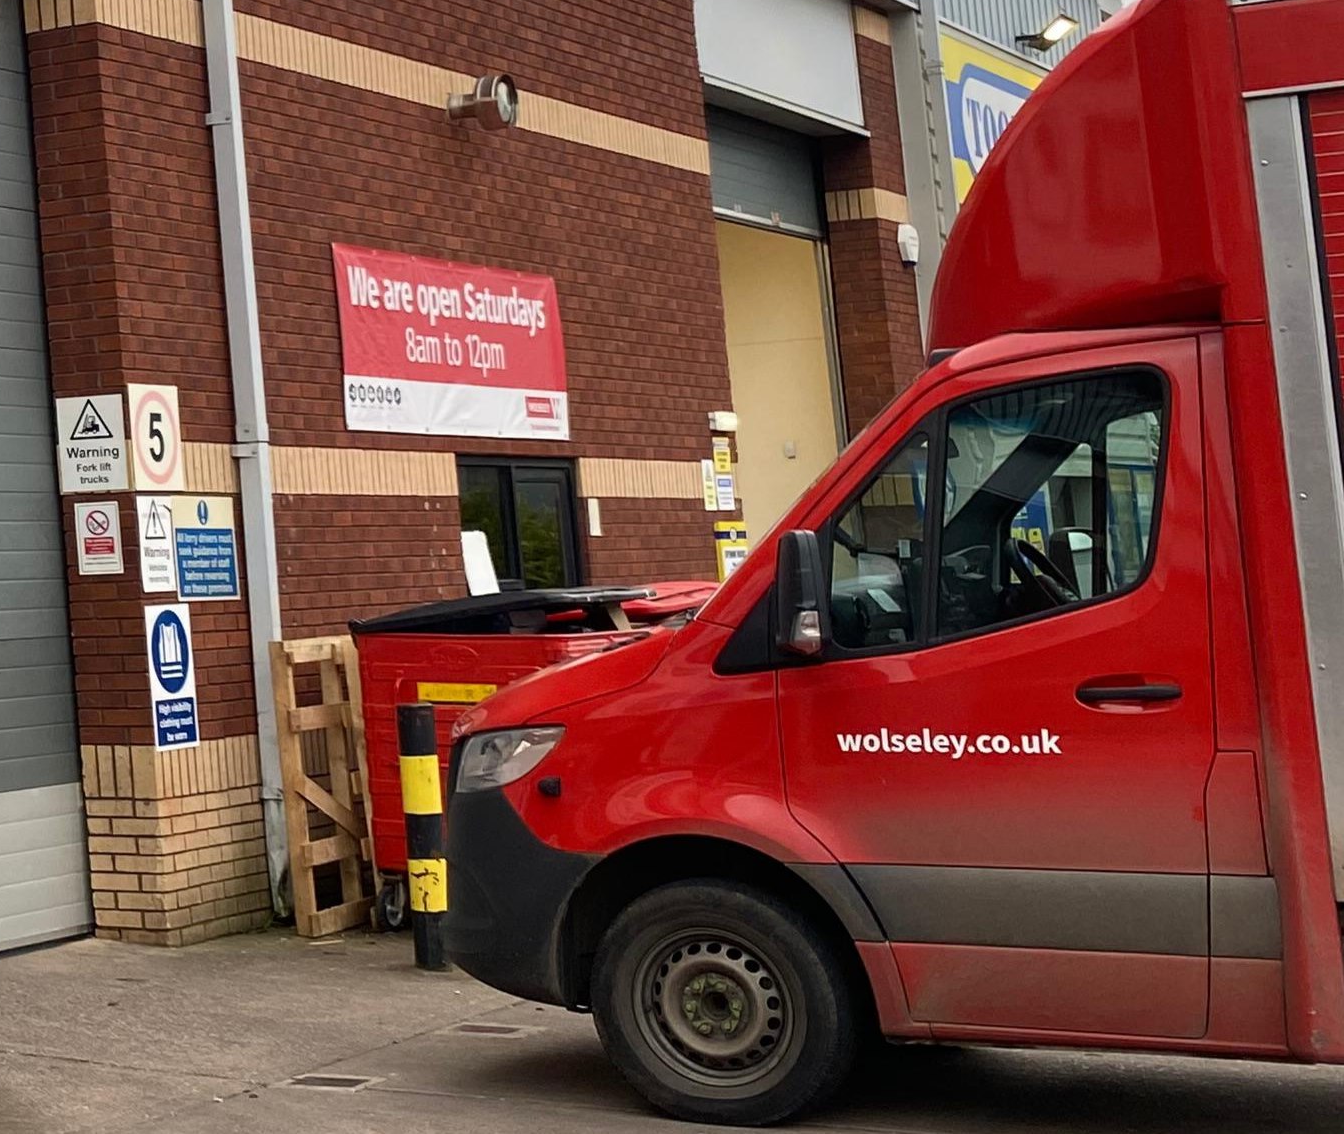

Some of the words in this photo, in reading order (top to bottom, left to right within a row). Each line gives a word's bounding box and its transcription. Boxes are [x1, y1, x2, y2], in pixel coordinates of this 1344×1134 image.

[346, 264, 380, 307] We
[382, 283, 414, 313] are
[417, 289, 462, 325] open
[464, 281, 546, 337] Saturdays
[405, 325, 442, 365] 8am
[445, 333, 462, 366] to
[465, 333, 506, 377] 12pm
[148, 412, 165, 462] 5
[66, 447, 120, 459] Warning
[76, 463, 98, 472] Fork
[99, 463, 112, 471] lift
[80, 475, 109, 484] trucks
[836, 727, 1061, 758] wolseley.co.uk
